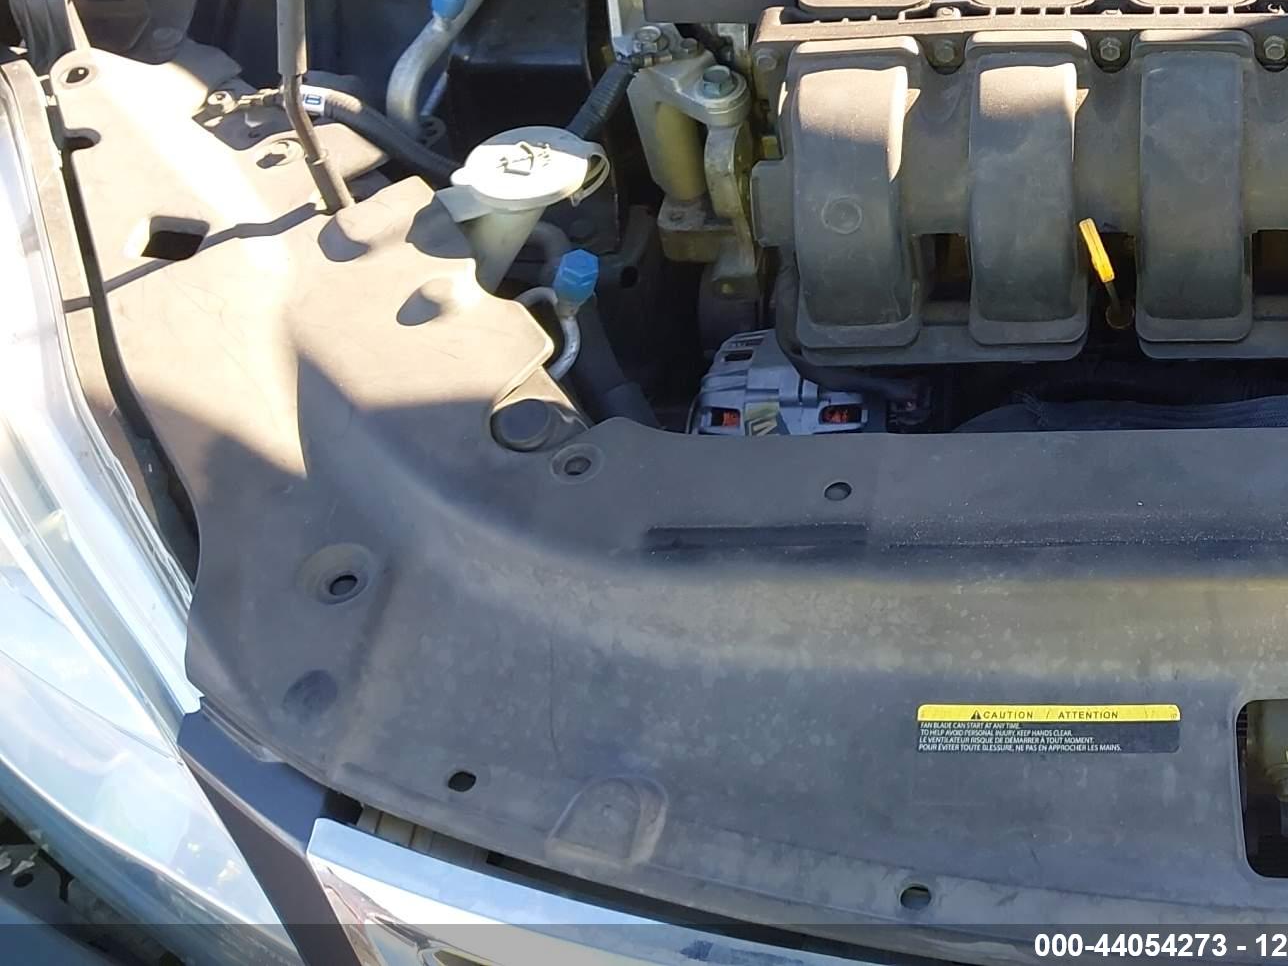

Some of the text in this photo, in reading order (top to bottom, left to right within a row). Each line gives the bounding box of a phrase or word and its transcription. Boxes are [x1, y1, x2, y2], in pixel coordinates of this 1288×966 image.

[983, 711, 1034, 720] CAUTION
[1058, 710, 1119, 719] ATTENTION
[919, 736, 927, 744] LE
[927, 736, 970, 744] VENTILATEUR
[971, 736, 994, 744] RISQUE
[994, 736, 1003, 744] DE
[1045, 736, 1063, 744] TOUT
[918, 743, 937, 751] POUR
[960, 743, 981, 751] TOUTE
[1015, 743, 1025, 751] NE
[1025, 743, 1038, 751] PAS
[1038, 743, 1047, 751] EN
[1047, 743, 1087, 751] APPROCHER
[1087, 743, 1099, 751] LES
